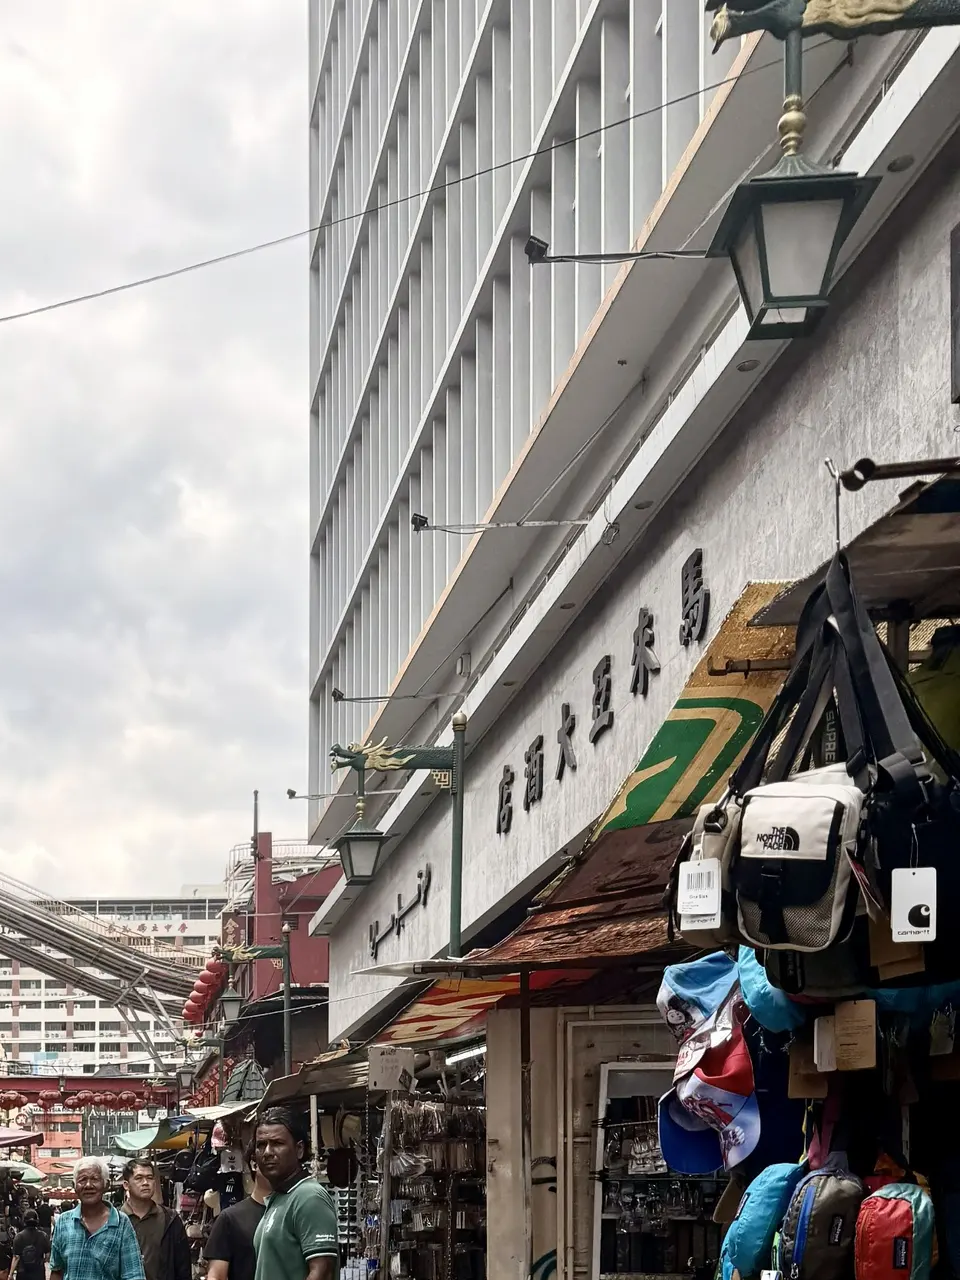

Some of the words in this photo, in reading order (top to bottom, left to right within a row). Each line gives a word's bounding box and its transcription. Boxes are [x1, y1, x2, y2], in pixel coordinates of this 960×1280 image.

[772, 826, 786, 835] THE
[756, 833, 784, 843] NORTH
[763, 842, 784, 851] FACE
